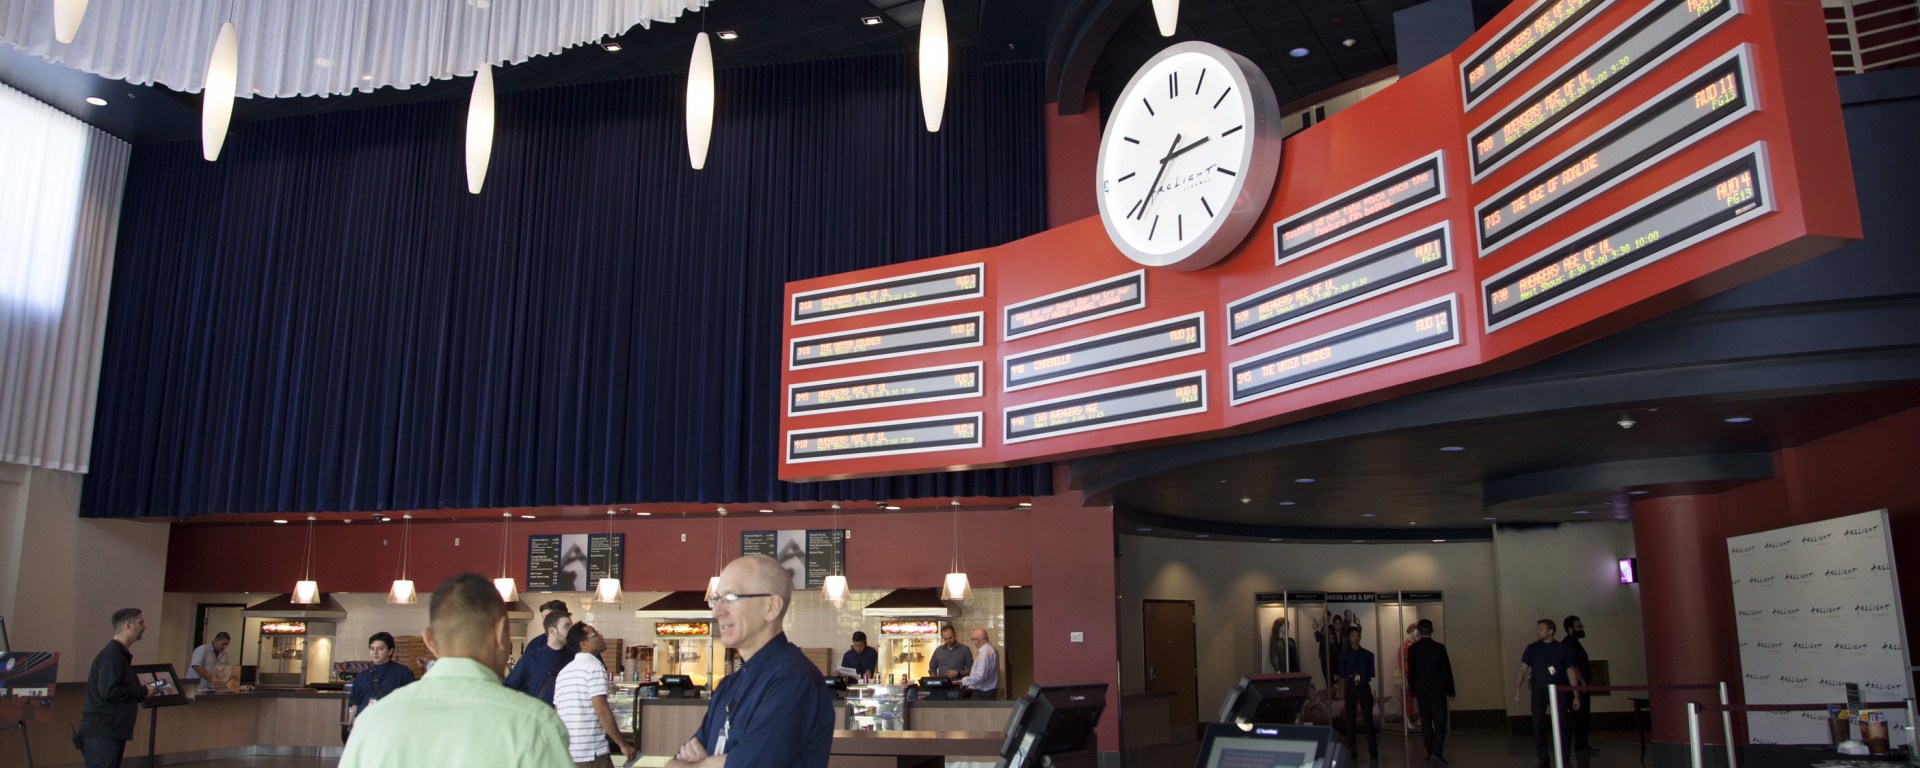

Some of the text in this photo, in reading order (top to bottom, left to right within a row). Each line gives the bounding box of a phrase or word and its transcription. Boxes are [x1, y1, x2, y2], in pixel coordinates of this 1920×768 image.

[1535, 12, 1551, 32] AGE
[1553, 0, 1563, 18] OF
[1611, 56, 1630, 74] 9:30
[1545, 89, 1560, 110] AGE
[1564, 79, 1574, 96] OF
[1579, 71, 1590, 86] UL
[1712, 89, 1738, 110] PG13
[1511, 195, 1526, 214] THE
[1529, 184, 1545, 204] AGE
[1548, 176, 1558, 192] OF
[1562, 153, 1598, 184] ADALINE
[1695, 84, 1717, 108] AUD
[1720, 74, 1734, 94] 11
[1388, 182, 1408, 196] once
[1412, 172, 1428, 185] the
[1563, 254, 1580, 270] AGE
[1584, 246, 1596, 262] OF
[1600, 239, 1613, 254] UL
[1716, 177, 1739, 200] AUD
[1742, 171, 1751, 187] 4
[1520, 188, 1752, 300] Next Shows: 8:30 9:00 9:30 10:00 PG13
[1422, 252, 1441, 264] PG13
[1296, 287, 1310, 302] AGE
[1312, 283, 1322, 296] OF
[1325, 278, 1334, 292] UL
[1415, 243, 1430, 258] AUD
[856, 292, 867, 301] AGE
[871, 290, 878, 299] OF
[956, 275, 968, 287] AUD
[1118, 285, 1130, 296] our
[820, 343, 832, 352] THE
[951, 324, 964, 335] AUD
[1170, 329, 1184, 341] AUD
[1262, 363, 1276, 378] THE
[1278, 356, 1300, 373] WATER
[1416, 316, 1432, 332] AUD
[1434, 312, 1447, 327] 12
[853, 386, 864, 395] AGE
[868, 385, 875, 393] OF
[954, 374, 968, 384] AUD
[1085, 402, 1098, 413] AGE
[1176, 386, 1190, 398] AUD
[852, 434, 864, 443] AGE
[867, 433, 874, 441] OF
[954, 424, 968, 434] AUD
